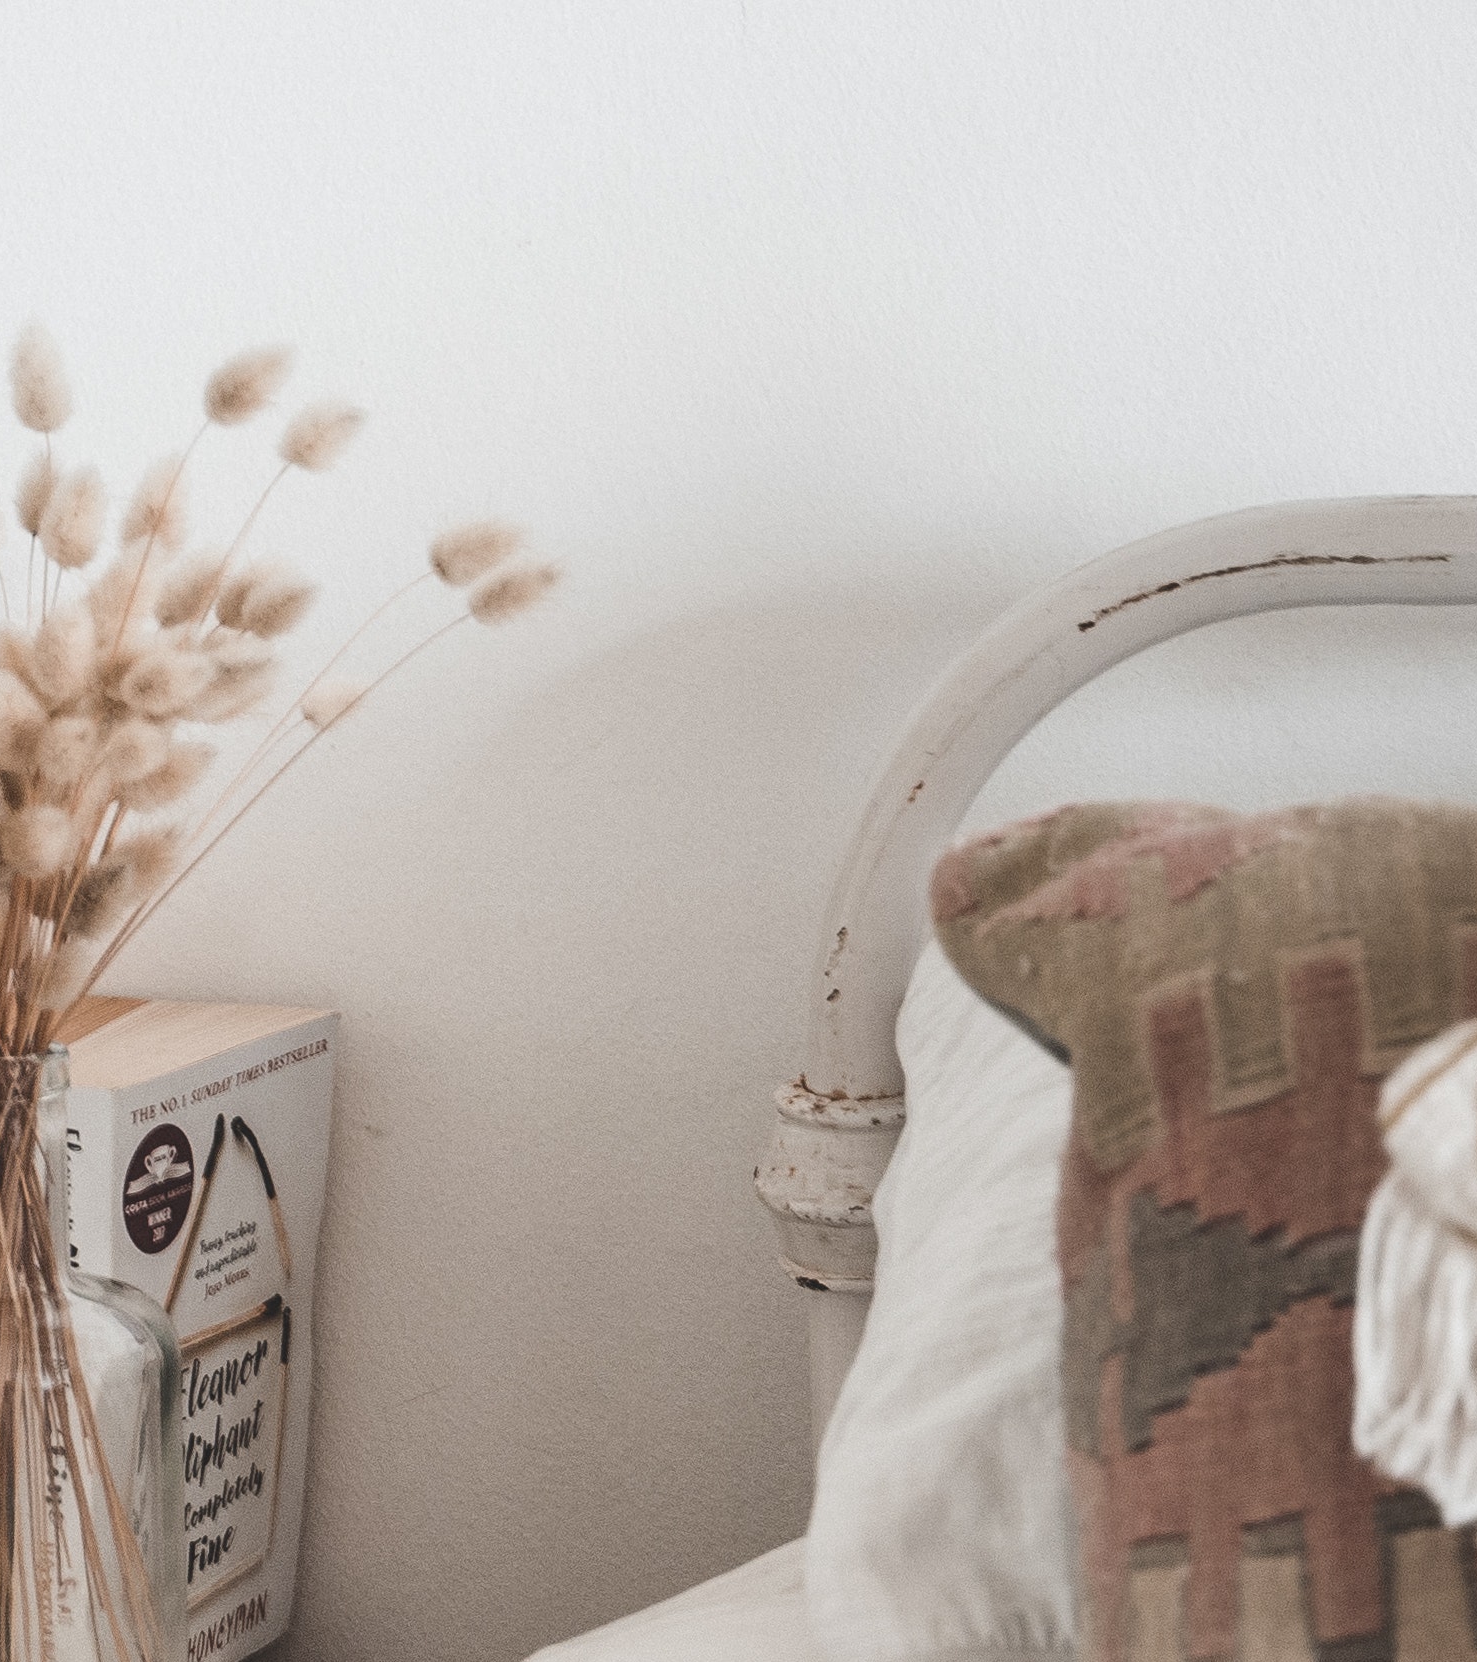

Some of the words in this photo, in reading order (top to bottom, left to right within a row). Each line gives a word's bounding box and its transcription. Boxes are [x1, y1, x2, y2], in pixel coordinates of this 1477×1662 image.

[130, 1104, 157, 1124] THE
[190, 1075, 233, 1104] SUNDAY
[235, 1061, 266, 1086] TIMES
[267, 1038, 329, 1073] BESTSELLER
[125, 1200, 148, 1216] COSTA
[183, 1399, 264, 1487] liphant
[185, 1462, 266, 1531] Completely
[187, 1525, 237, 1584] Fine
